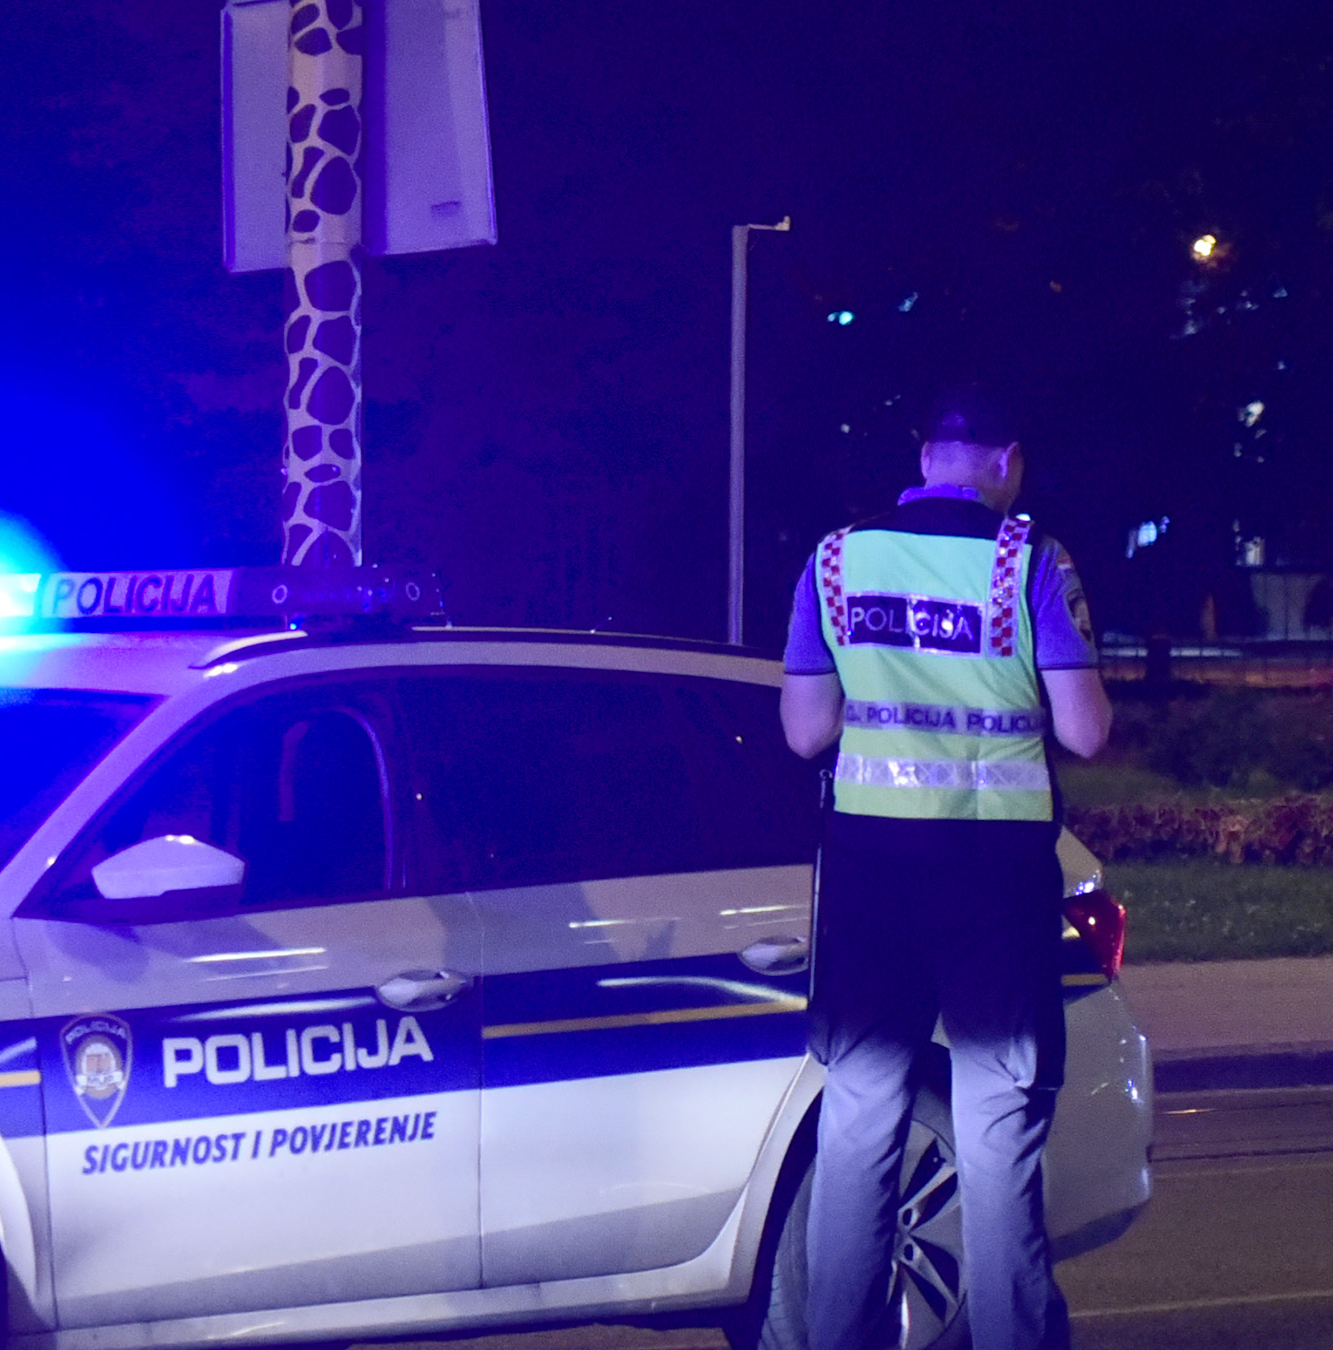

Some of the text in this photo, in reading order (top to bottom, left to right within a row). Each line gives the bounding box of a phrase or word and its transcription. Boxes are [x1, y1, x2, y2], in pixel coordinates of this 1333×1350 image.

[53, 574, 216, 615] POLICIJA
[850, 606, 975, 641] POLICIJA
[866, 707, 956, 729] POLICIJA
[163, 1016, 434, 1088] POLICIJA
[82, 1111, 438, 1175] SIGURNOST I POVJERENJE
